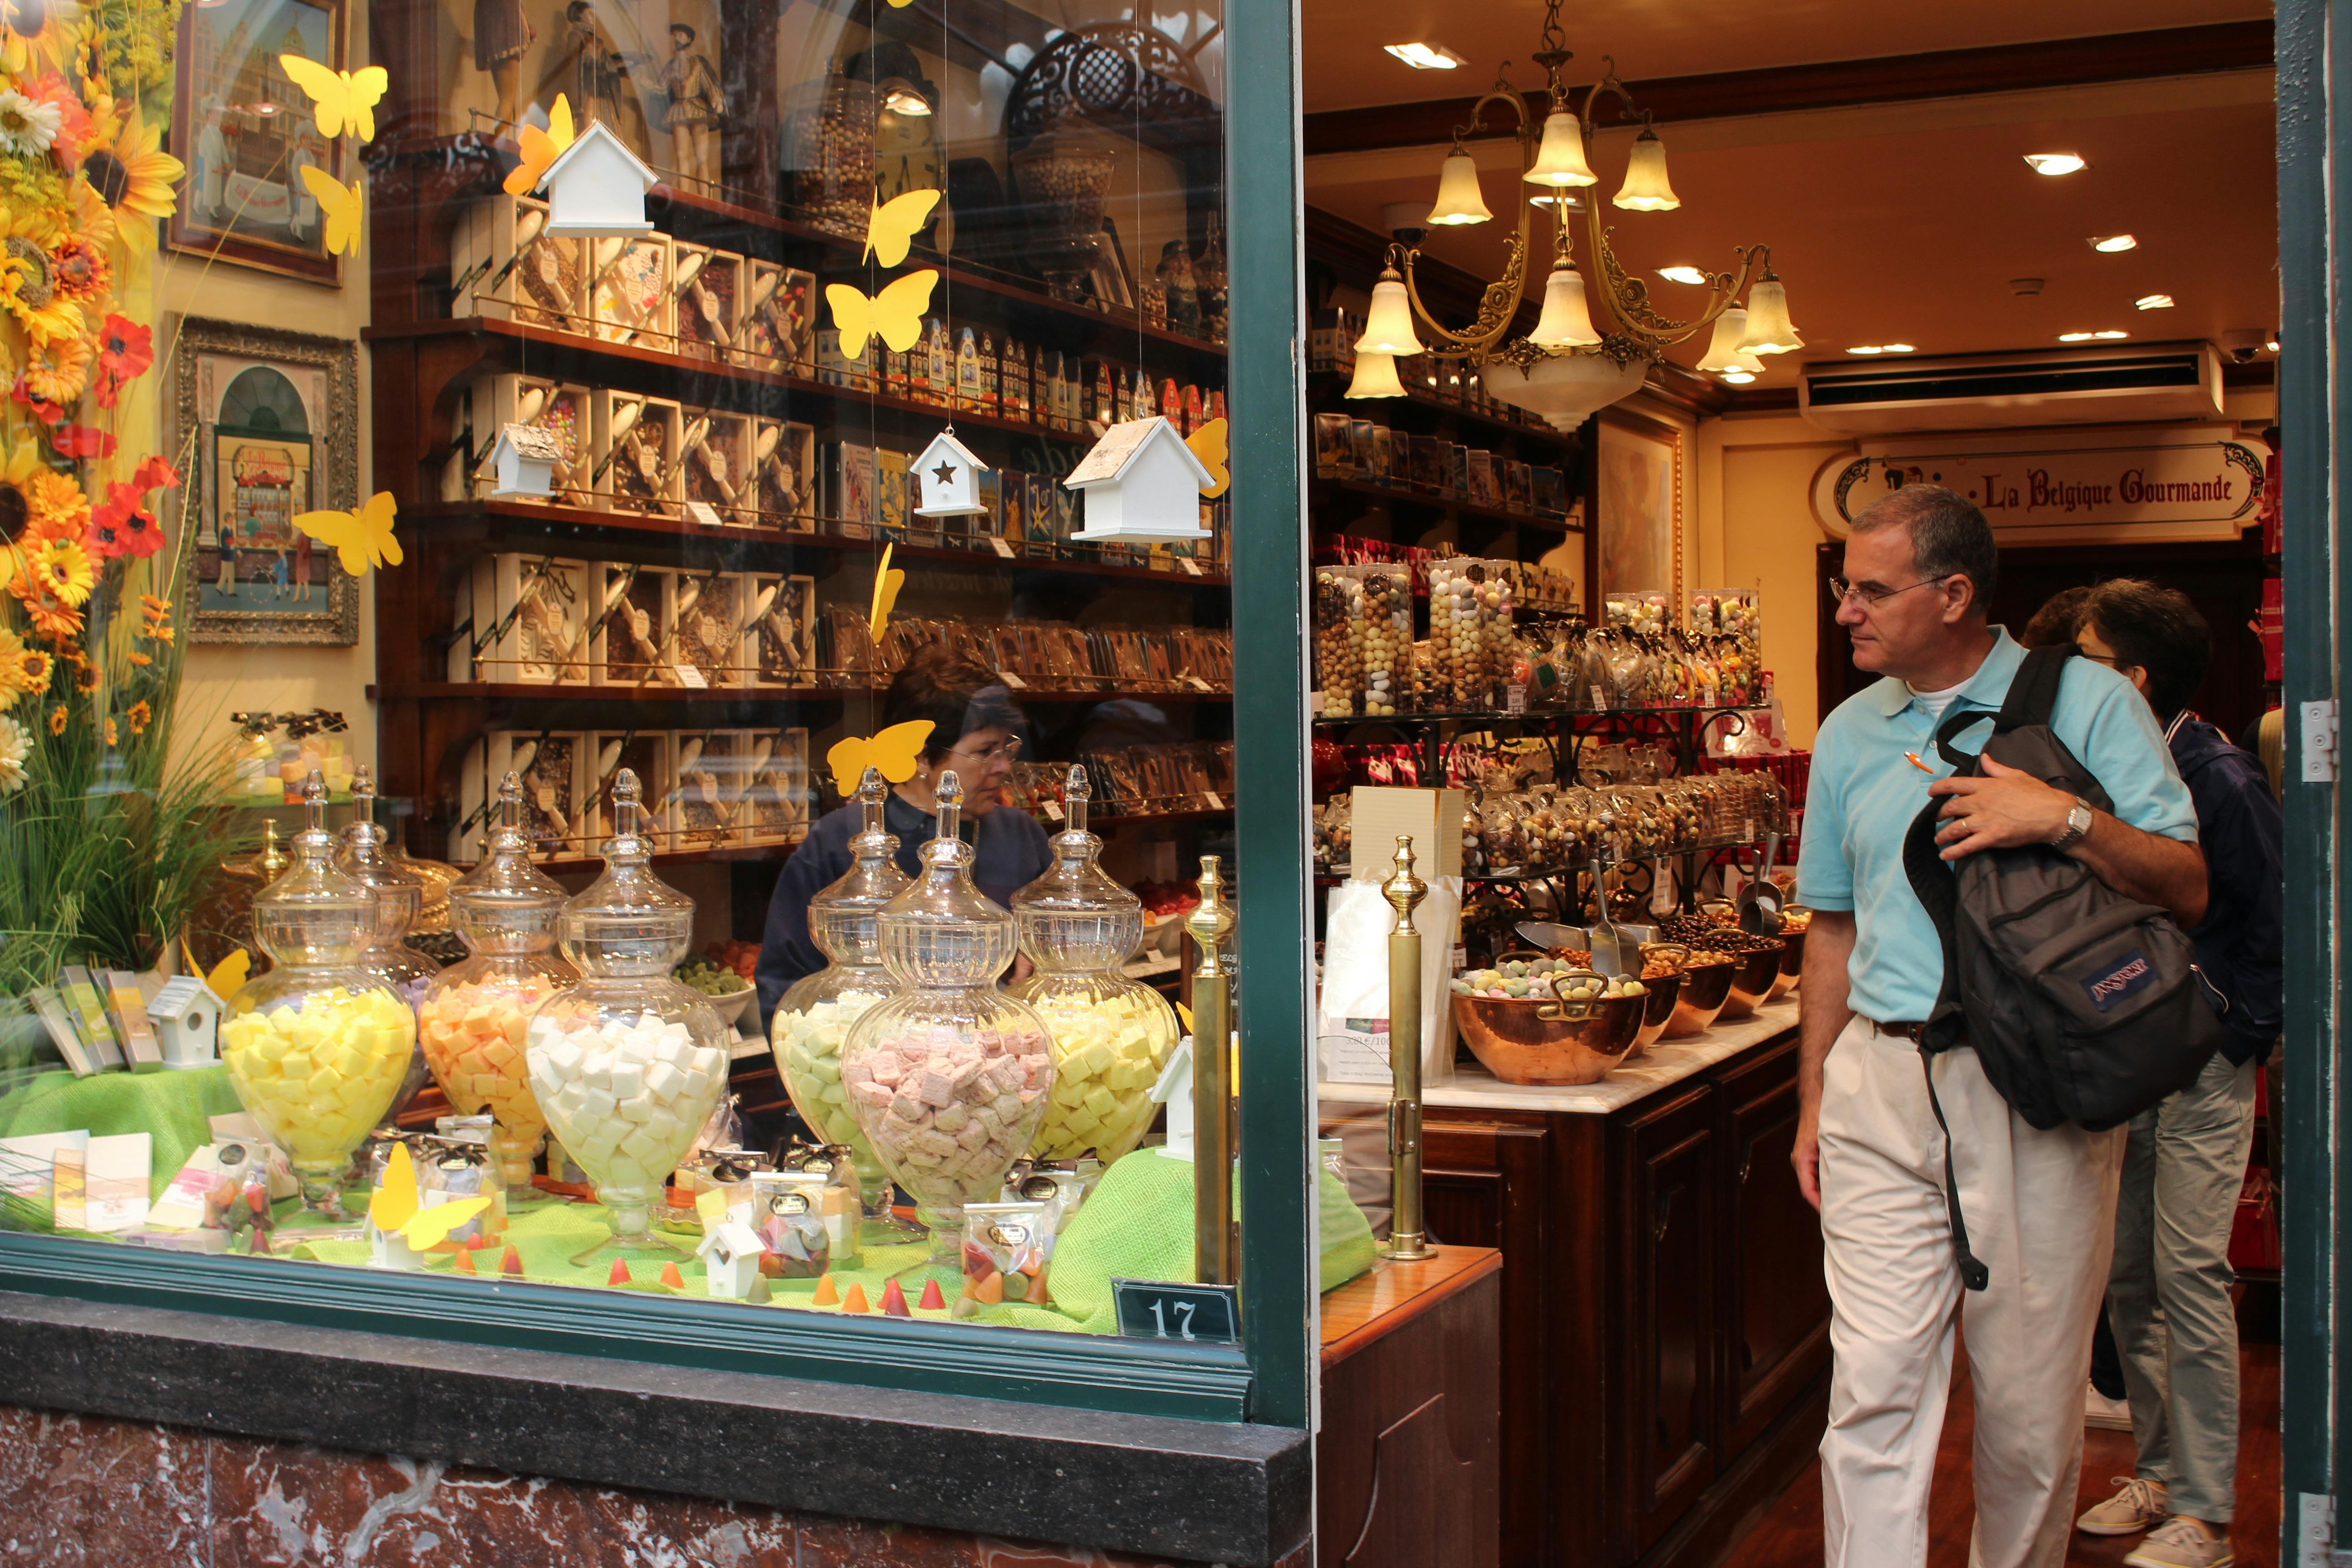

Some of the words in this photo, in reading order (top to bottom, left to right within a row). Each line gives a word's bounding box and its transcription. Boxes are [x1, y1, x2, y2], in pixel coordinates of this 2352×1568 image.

[1981, 474, 2019, 511] La
[2027, 469, 2112, 513] Belgique
[2119, 468, 2232, 504] Gourmande
[1148, 1298, 1196, 1341] 17
